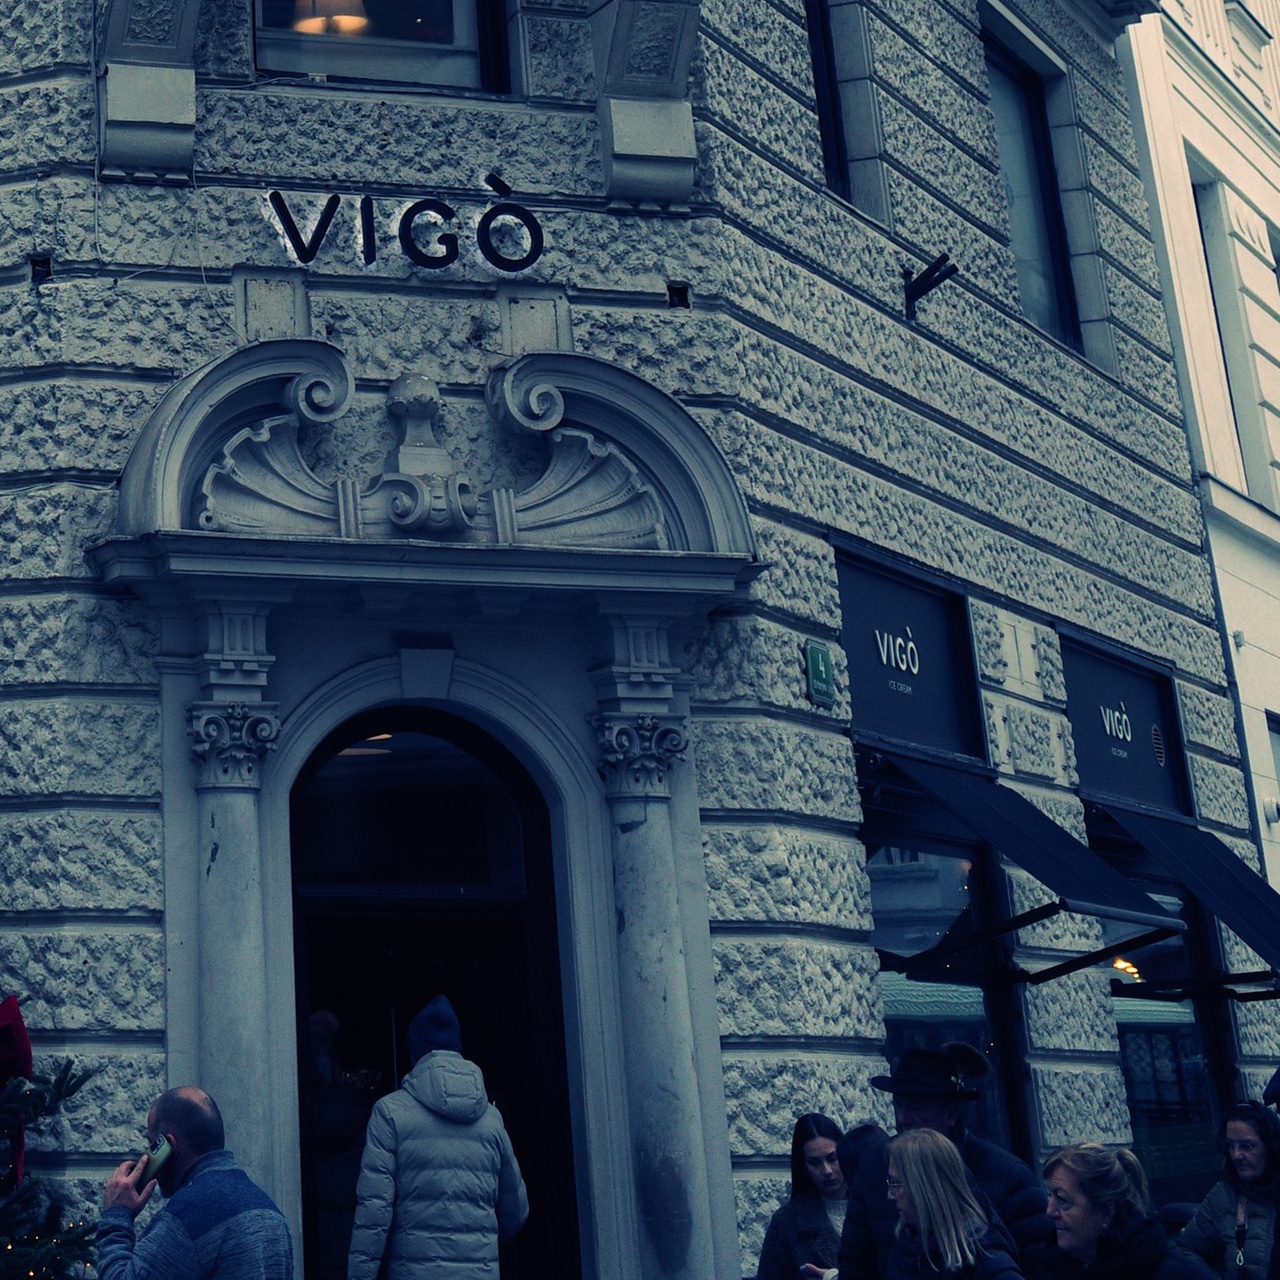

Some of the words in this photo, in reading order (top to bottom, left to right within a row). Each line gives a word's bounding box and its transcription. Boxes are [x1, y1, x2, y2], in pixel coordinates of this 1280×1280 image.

[270, 173, 544, 272] VIGÒ
[875, 626, 919, 675] VIGÒ
[1100, 701, 1131, 742] VIGÒ
